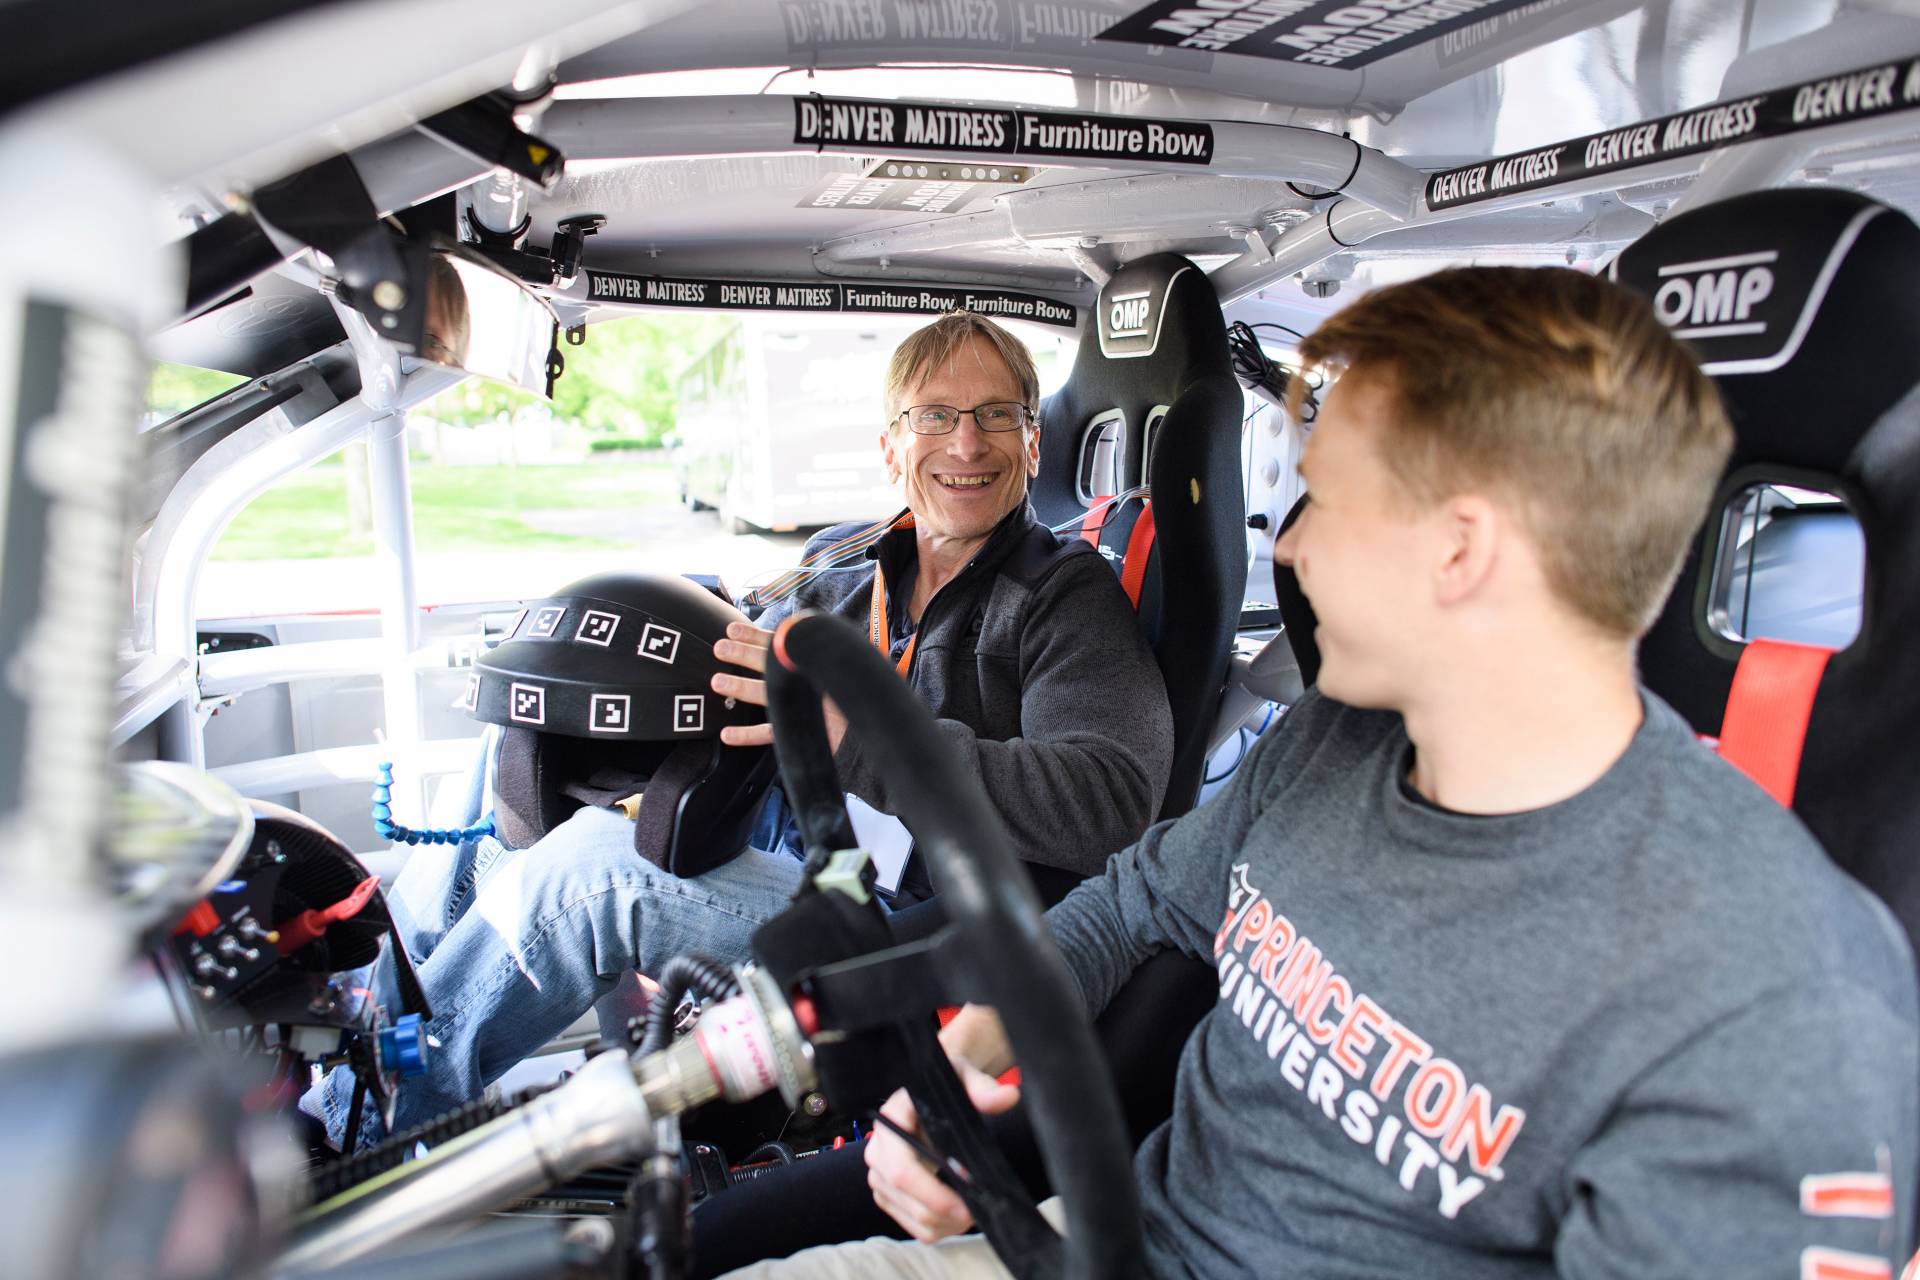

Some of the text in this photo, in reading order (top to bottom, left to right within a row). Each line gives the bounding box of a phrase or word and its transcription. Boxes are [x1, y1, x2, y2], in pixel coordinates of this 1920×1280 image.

[1293, 0, 1499, 66] URNITURE
[904, 109, 1005, 147] MATTRESS
[1023, 116, 1143, 153] Furniture
[1433, 166, 1486, 203] DENVER
[1491, 148, 1560, 189] MATTRESS
[1585, 123, 1657, 169] DENVER
[1663, 98, 1758, 152] MATTRESS
[1793, 65, 1898, 123] DENVER
[593, 276, 832, 306] DENVER MATTRESS DENVER MATTRESS
[847, 290, 917, 308] Furniture
[966, 295, 1033, 314] Furniture
[1111, 299, 1149, 331] OMP
[1654, 266, 1774, 327] OMP
[1233, 898, 1526, 1175] PRINCETON
[1219, 952, 1485, 1219] UNIVERSITY
